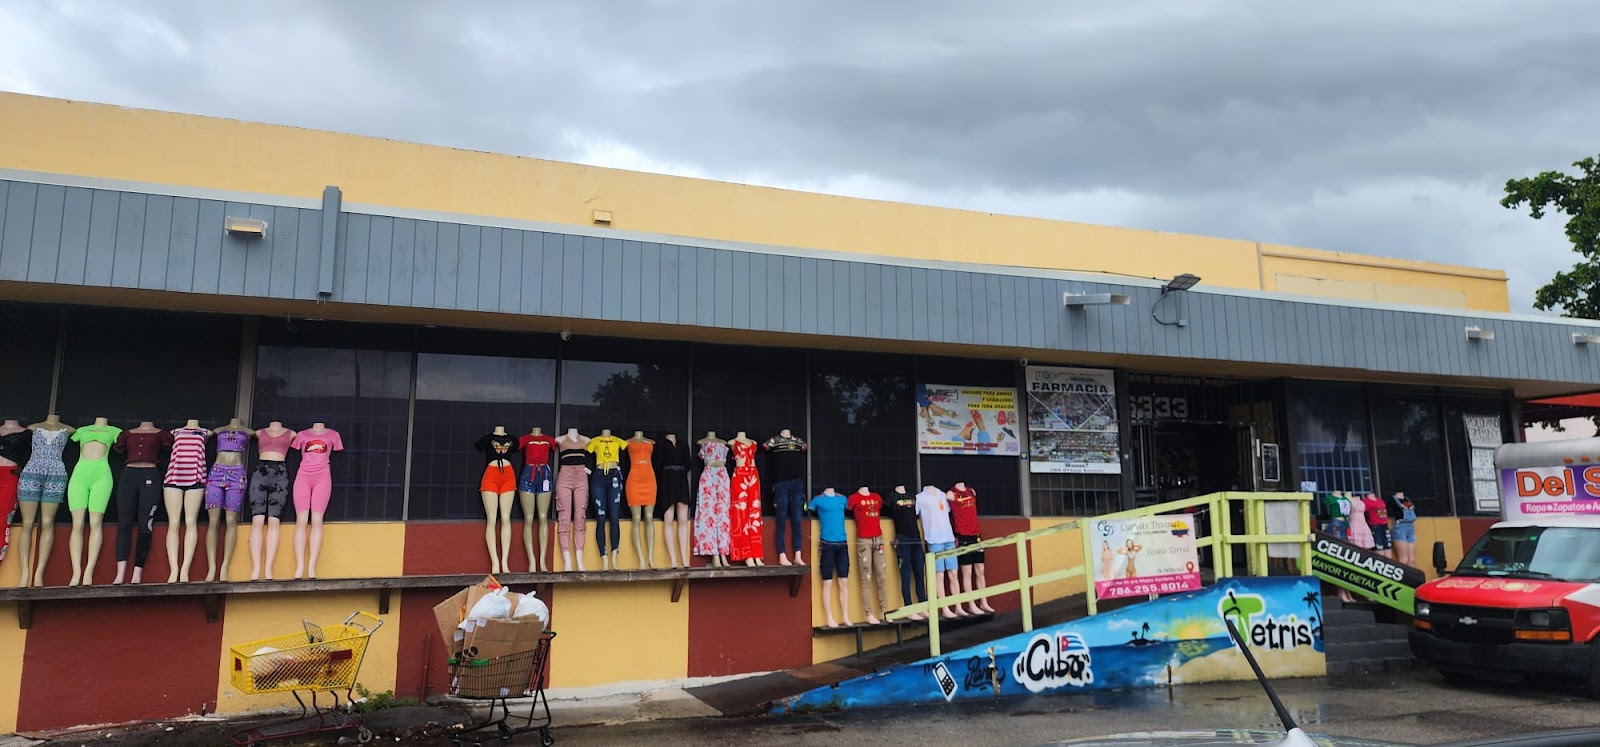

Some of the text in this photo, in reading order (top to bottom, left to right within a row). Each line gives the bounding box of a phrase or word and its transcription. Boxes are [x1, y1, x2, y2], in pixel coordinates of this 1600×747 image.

[1032, 382, 1108, 393] FARMACIA
[1515, 468, 1576, 497] Del
[1526, 503, 1546, 513] Ropa
[1553, 502, 1585, 512] Zapatos
[1312, 558, 1377, 590] MAYOR Y DETAL
[1317, 540, 1404, 581] CELULARES
[1109, 582, 1189, 596] 786.255.8014
[1221, 596, 1312, 650] Tetris
